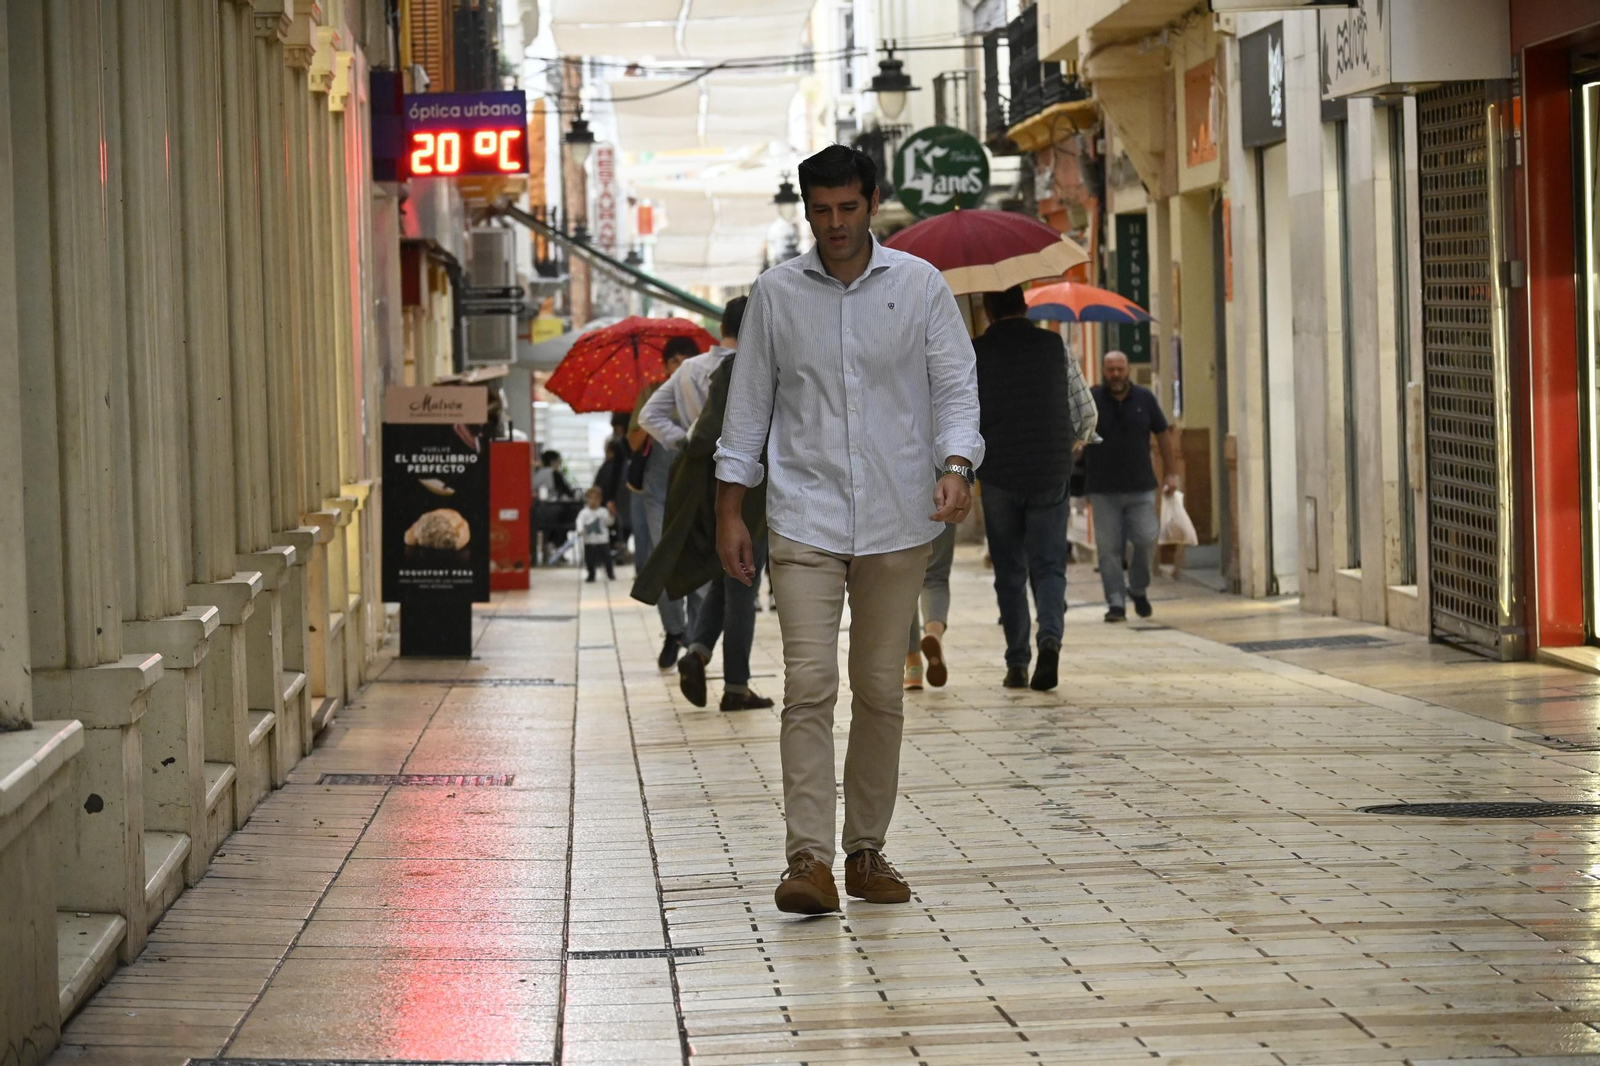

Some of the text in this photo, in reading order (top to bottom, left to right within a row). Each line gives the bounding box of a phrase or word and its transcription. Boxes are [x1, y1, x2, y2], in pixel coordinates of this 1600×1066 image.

[409, 101, 521, 121] óptica urbano
[411, 132, 460, 174] 20
[1129, 222, 1143, 353] Herbolio
[395, 453, 478, 464] EL EQUILIBRIO
[407, 464, 465, 474] PERFECTO
[398, 569, 473, 577] ROQUEFORT PERA
